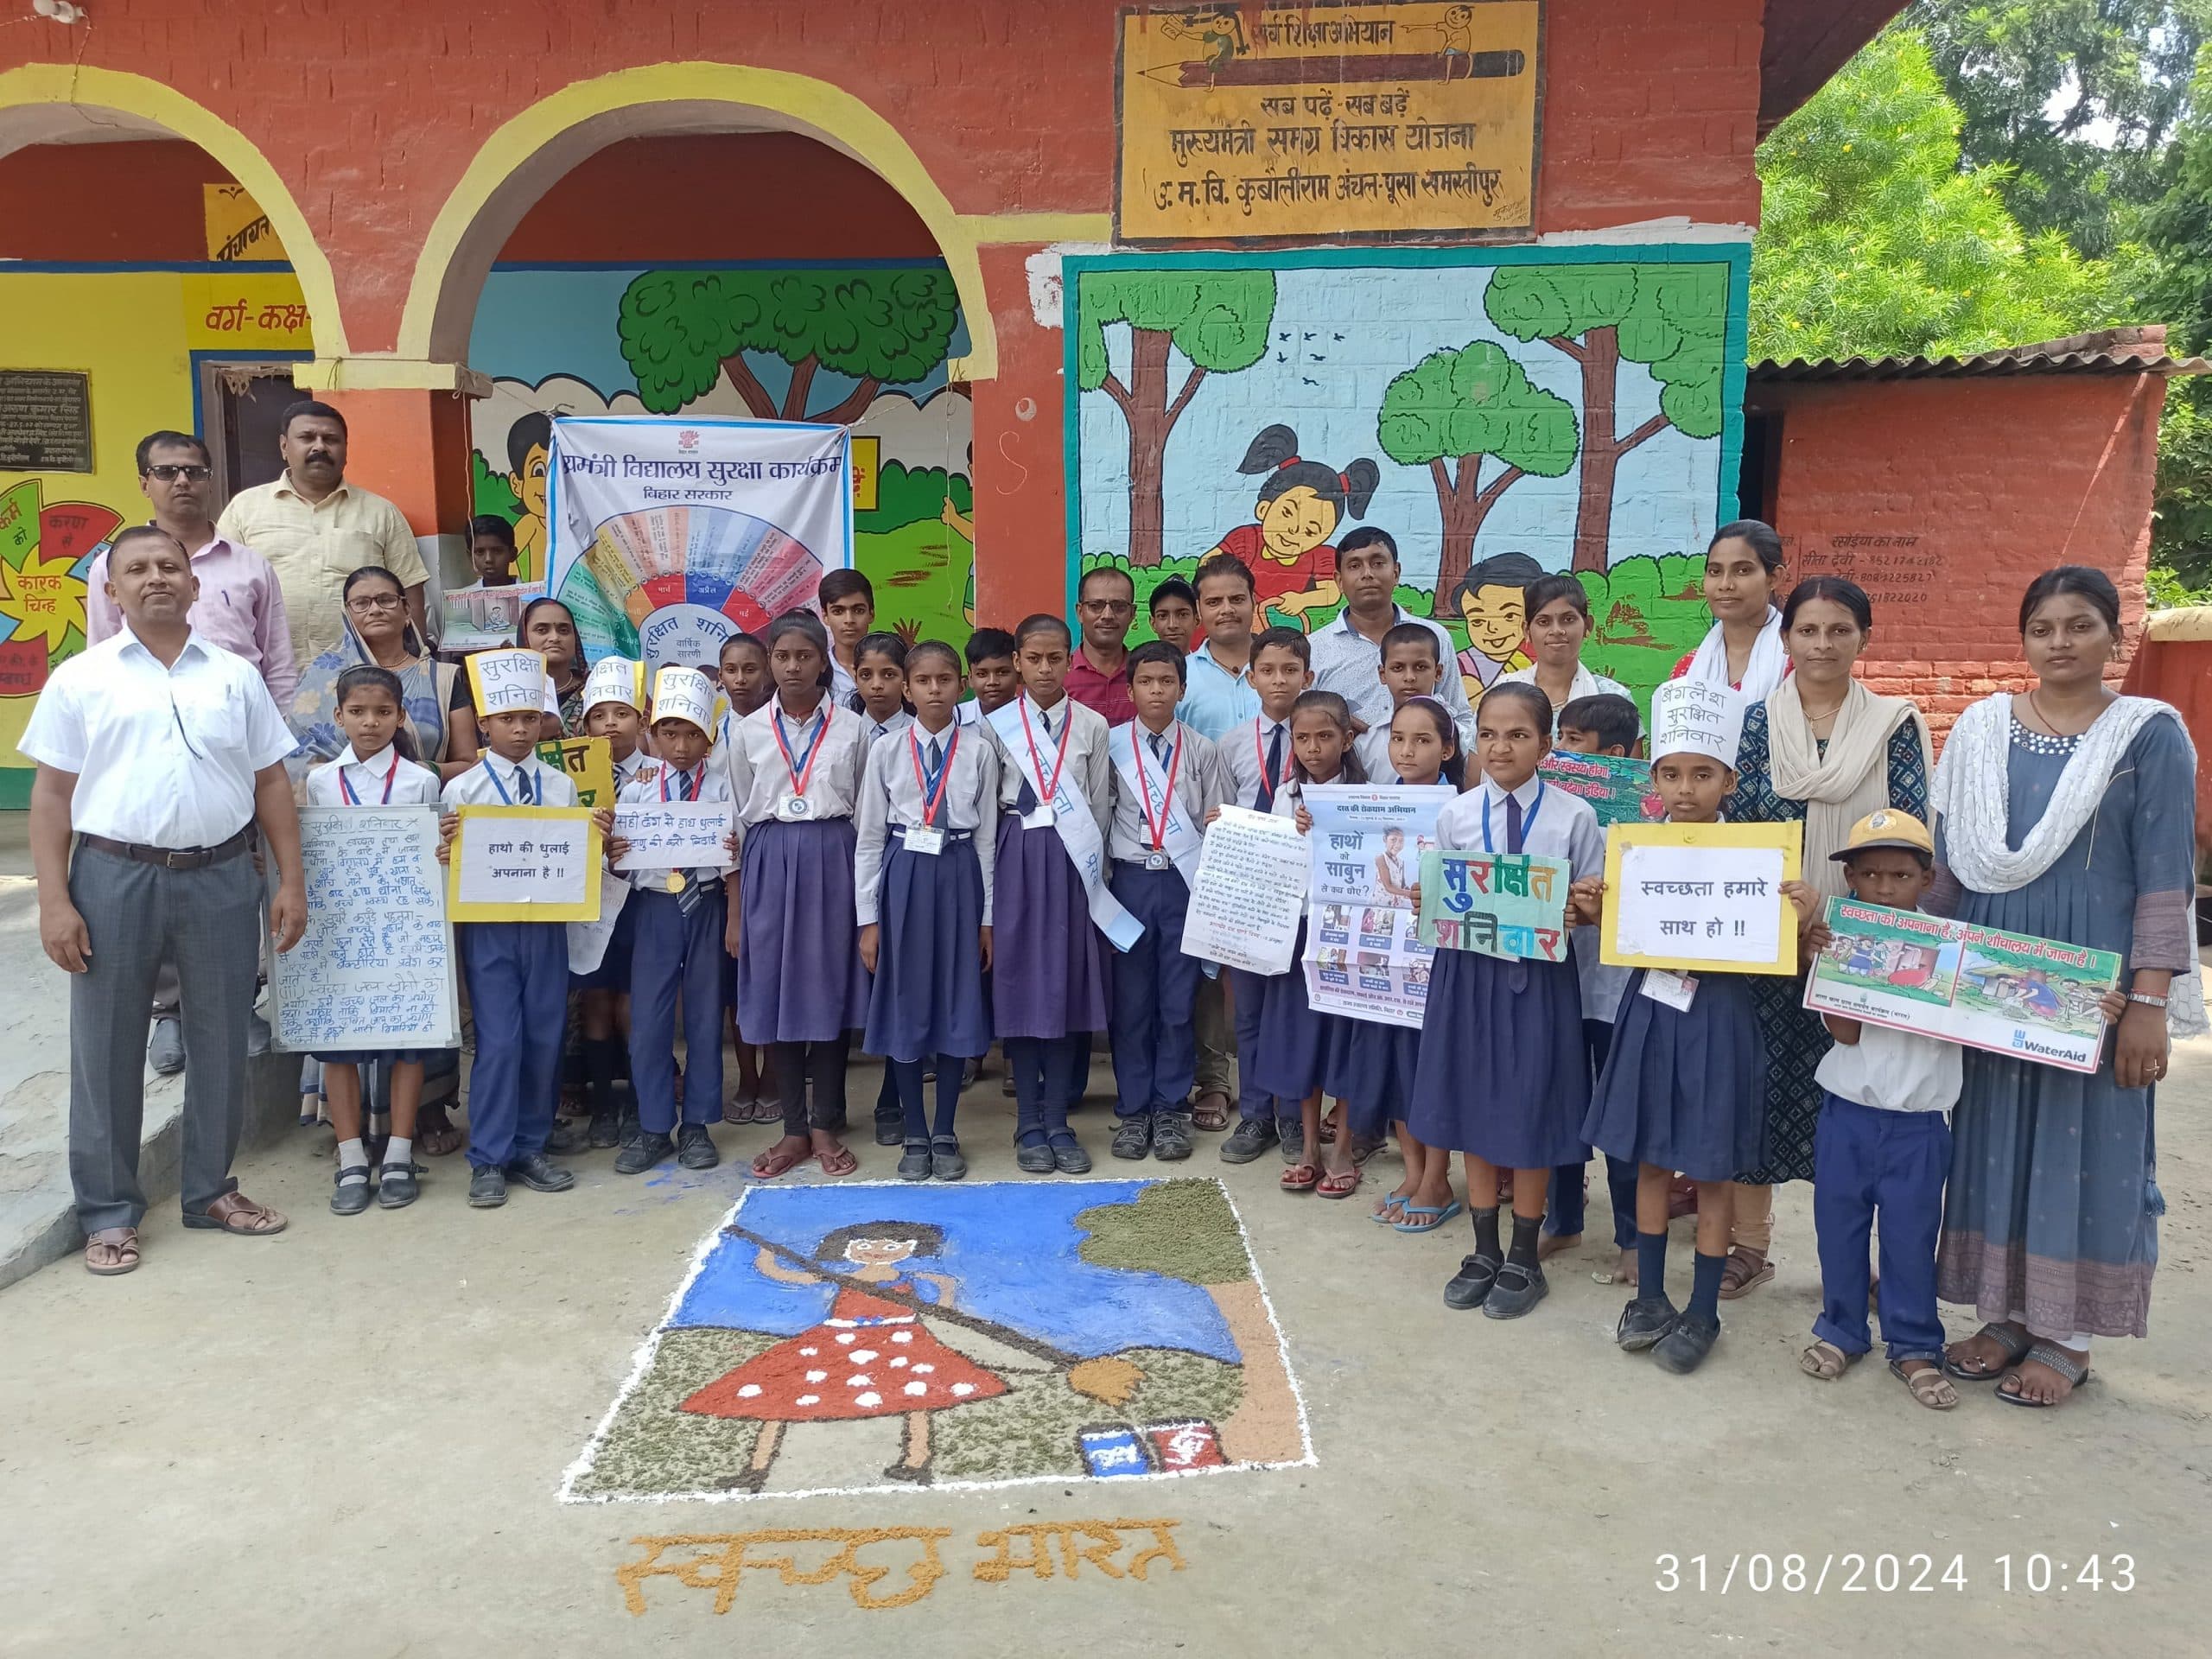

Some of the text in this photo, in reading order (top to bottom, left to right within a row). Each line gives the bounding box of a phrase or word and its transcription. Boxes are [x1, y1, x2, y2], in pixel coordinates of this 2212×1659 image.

[1260, 96, 1296, 118] सब
[1345, 95, 1376, 118] सब
[1267, 127, 1322, 157] समग्र
[1331, 119, 1399, 154] विकास
[1405, 116, 1477, 152] योजना
[1421, 162, 1504, 207] समस्तीपुर
[623, 454, 701, 479] विद्यालय
[706, 461, 763, 486] सुरक्षा
[769, 455, 842, 480] कार्यक्रम
[685, 488, 733, 501] सरकार
[14, 526, 28, 547] को
[1873, 536, 1891, 547] का
[1892, 536, 1919, 548] नाम
[1831, 550, 1857, 567] देवी
[17, 575, 62, 593] कारक
[658, 584, 671, 594] मार्च
[698, 586, 716, 594] अप्रैल
[24, 591, 57, 614] चिन्ह
[739, 608, 751, 618] मई
[645, 616, 730, 659] सुरक्षित शनि
[676, 637, 701, 648] वार्षिक
[677, 649, 701, 659] सारणी
[480, 652, 541, 681] सुरक्षित
[658, 693, 712, 728] शनिवार
[1667, 703, 1726, 728] सुरक्षित
[1660, 724, 1727, 753] शनिवार
[1585, 781, 1608, 798] इंडिया
[1388, 804, 1416, 814] अभियान
[616, 811, 727, 831] सही ढंग से हाथ धुलाई
[519, 841, 534, 854] की
[539, 841, 570, 858] धुलाई
[627, 837, 647, 852] टाणु
[665, 833, 685, 847] करो
[1329, 830, 1364, 850] हाथों
[1340, 852, 1350, 861] को
[492, 868, 537, 878] अपनाना
[543, 865, 550, 880] है
[1325, 861, 1365, 884] साबुन
[1320, 883, 1328, 893] से
[1442, 854, 1559, 913] सुरक्षित
[1641, 876, 1769, 899] स्वच्छता हमारे
[1432, 911, 1560, 961] शनिवार
[1659, 919, 1697, 936] साथ
[1706, 917, 1725, 938] हो
[1840, 905, 1878, 923] स्वच्छता
[1879, 912, 1895, 925] को
[1897, 917, 1939, 936] अपनाना
[1955, 928, 1985, 944] अपने
[1986, 932, 2031, 955] शौचालय
[2032, 941, 2047, 958] में
[2047, 948, 2075, 963] जाना
[2075, 950, 2088, 968] है
[2024, 1040, 2088, 1064] WaterAid
[972, 1517, 1185, 1584] भारत
